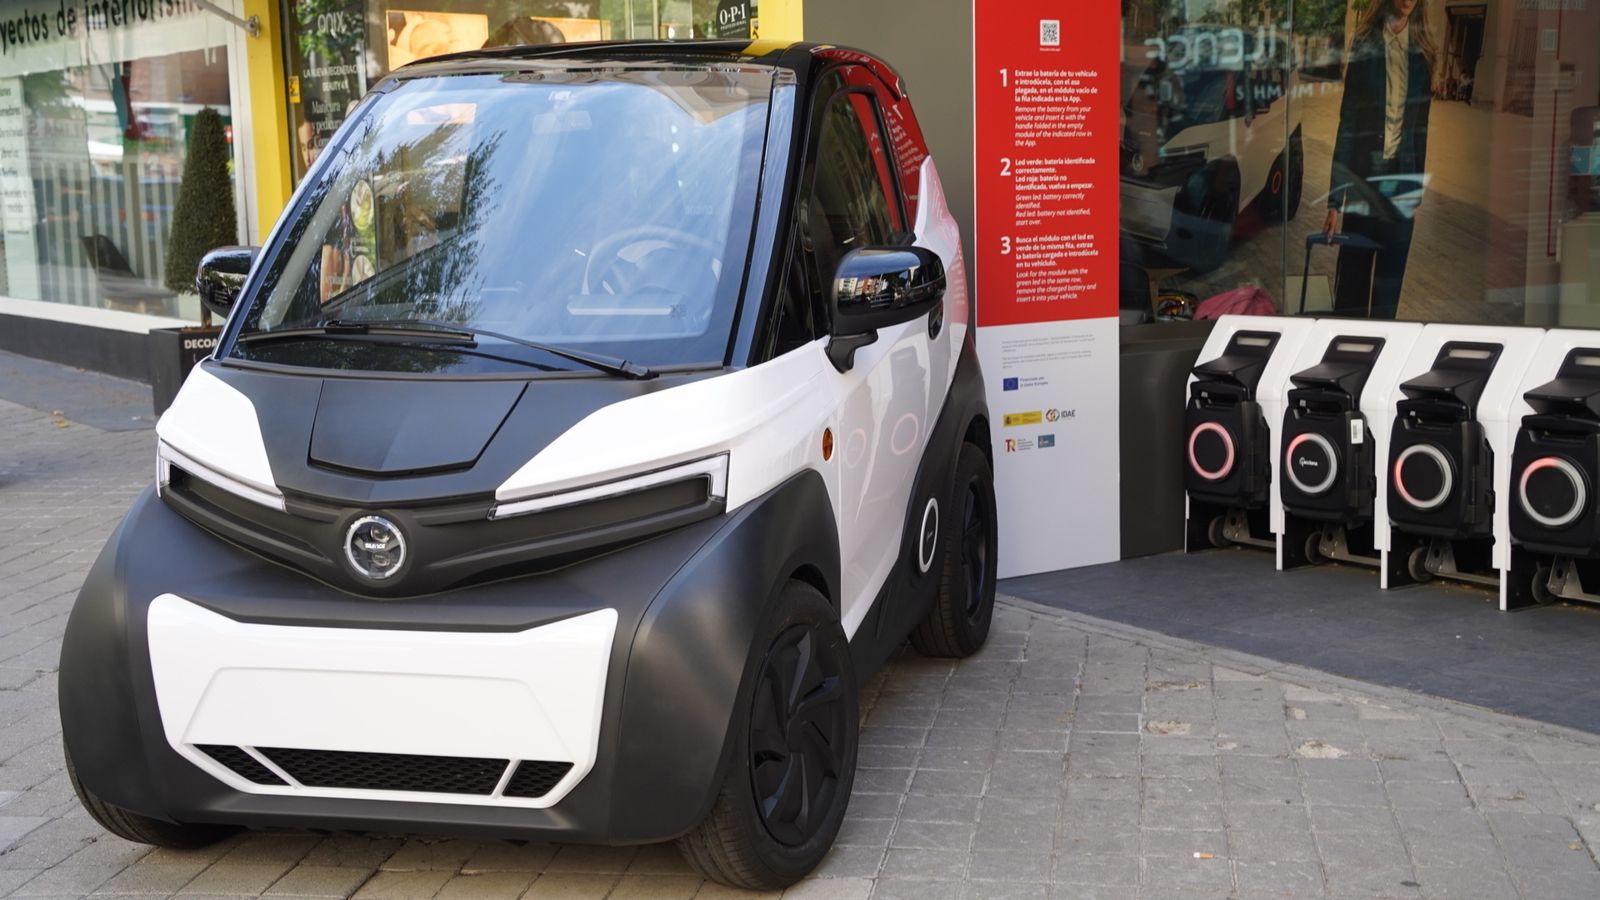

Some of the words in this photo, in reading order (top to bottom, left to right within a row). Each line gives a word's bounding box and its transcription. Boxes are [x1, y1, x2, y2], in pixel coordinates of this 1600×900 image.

[57, 0, 77, 36] de
[85, 0, 204, 33] interiorism
[1000, 69, 1007, 87] 1
[1015, 87, 1038, 96] plegada,
[1000, 158, 1011, 176] 2
[1001, 236, 1010, 254] 3
